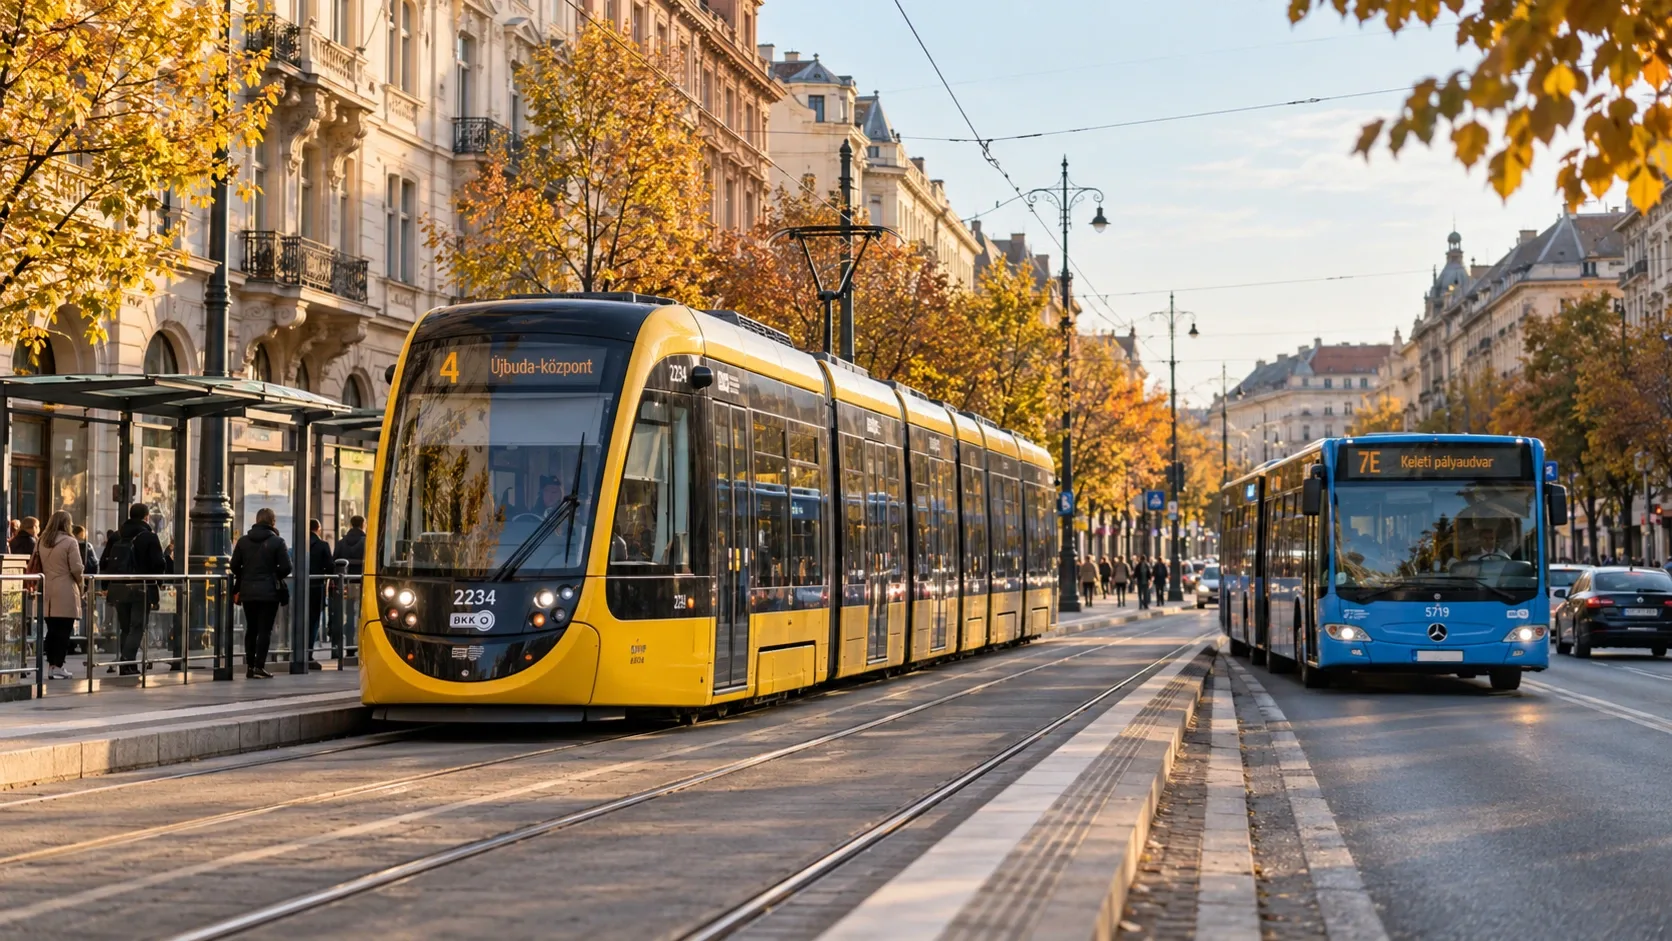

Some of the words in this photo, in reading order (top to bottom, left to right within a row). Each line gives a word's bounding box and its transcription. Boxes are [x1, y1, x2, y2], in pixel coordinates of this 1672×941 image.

[439, 351, 460, 384] 4
[491, 355, 593, 377] Újbuda-központ
[669, 364, 687, 383] 2234
[1357, 450, 1381, 474] 7E
[1401, 455, 1432, 468] Keleti
[1434, 455, 1494, 470] pályaudvar
[453, 589, 496, 606] 2234
[453, 615, 476, 625] BKK
[1425, 606, 1450, 618] 5719
